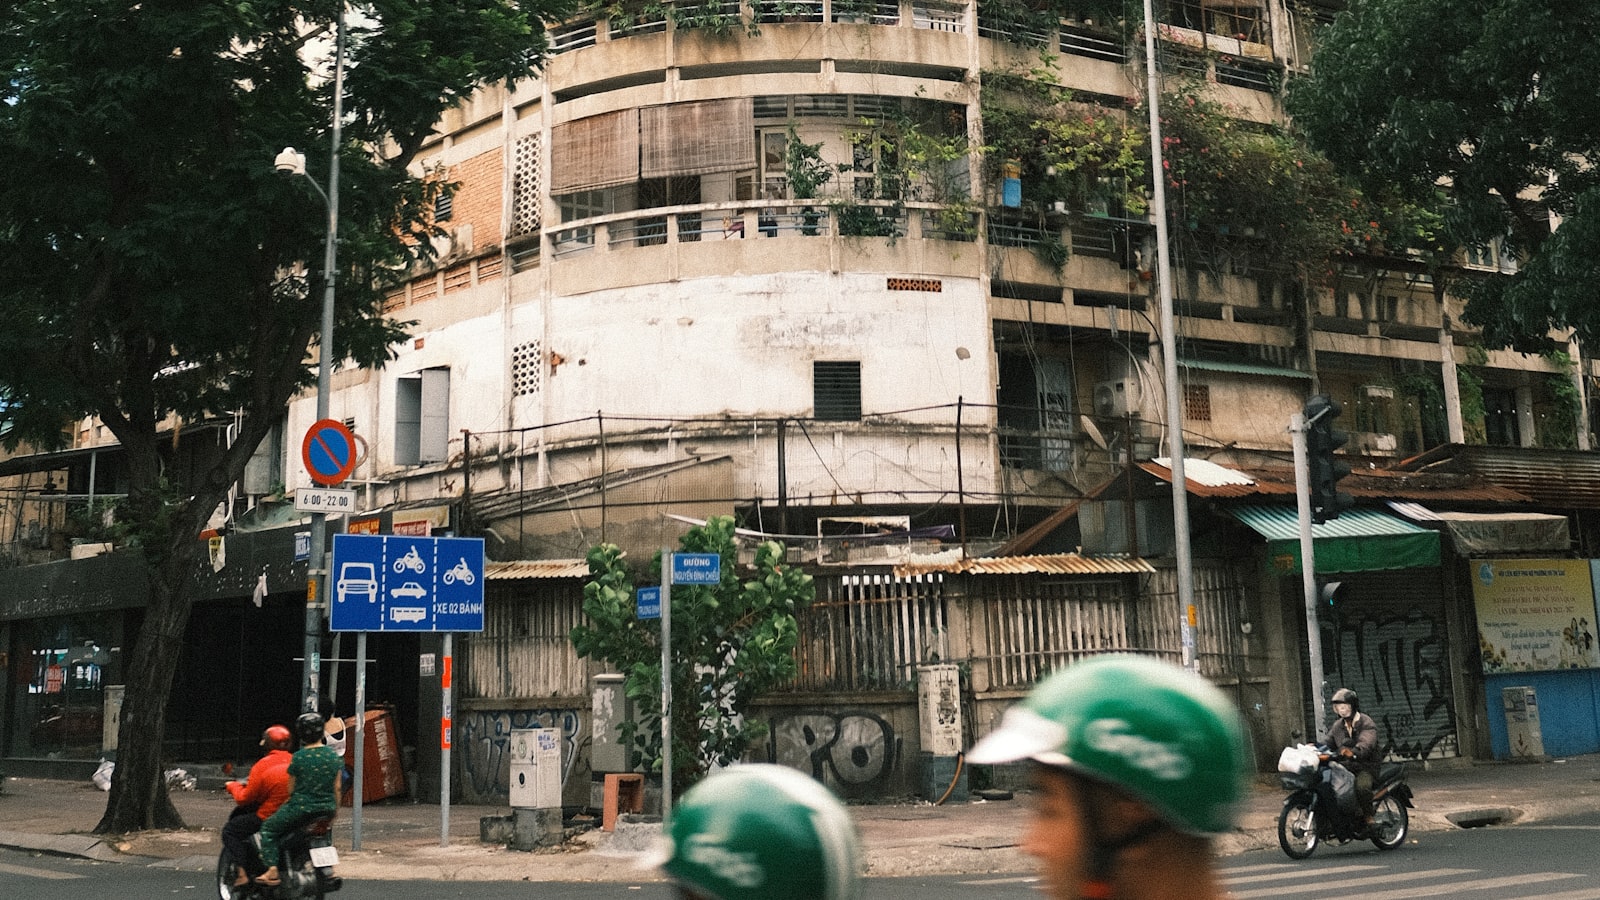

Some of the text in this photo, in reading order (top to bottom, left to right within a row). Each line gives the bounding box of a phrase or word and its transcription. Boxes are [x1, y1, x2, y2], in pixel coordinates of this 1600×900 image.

[683, 558, 710, 567] ĐƯỜNG
[436, 600, 482, 614] XE 02 BÁNH
